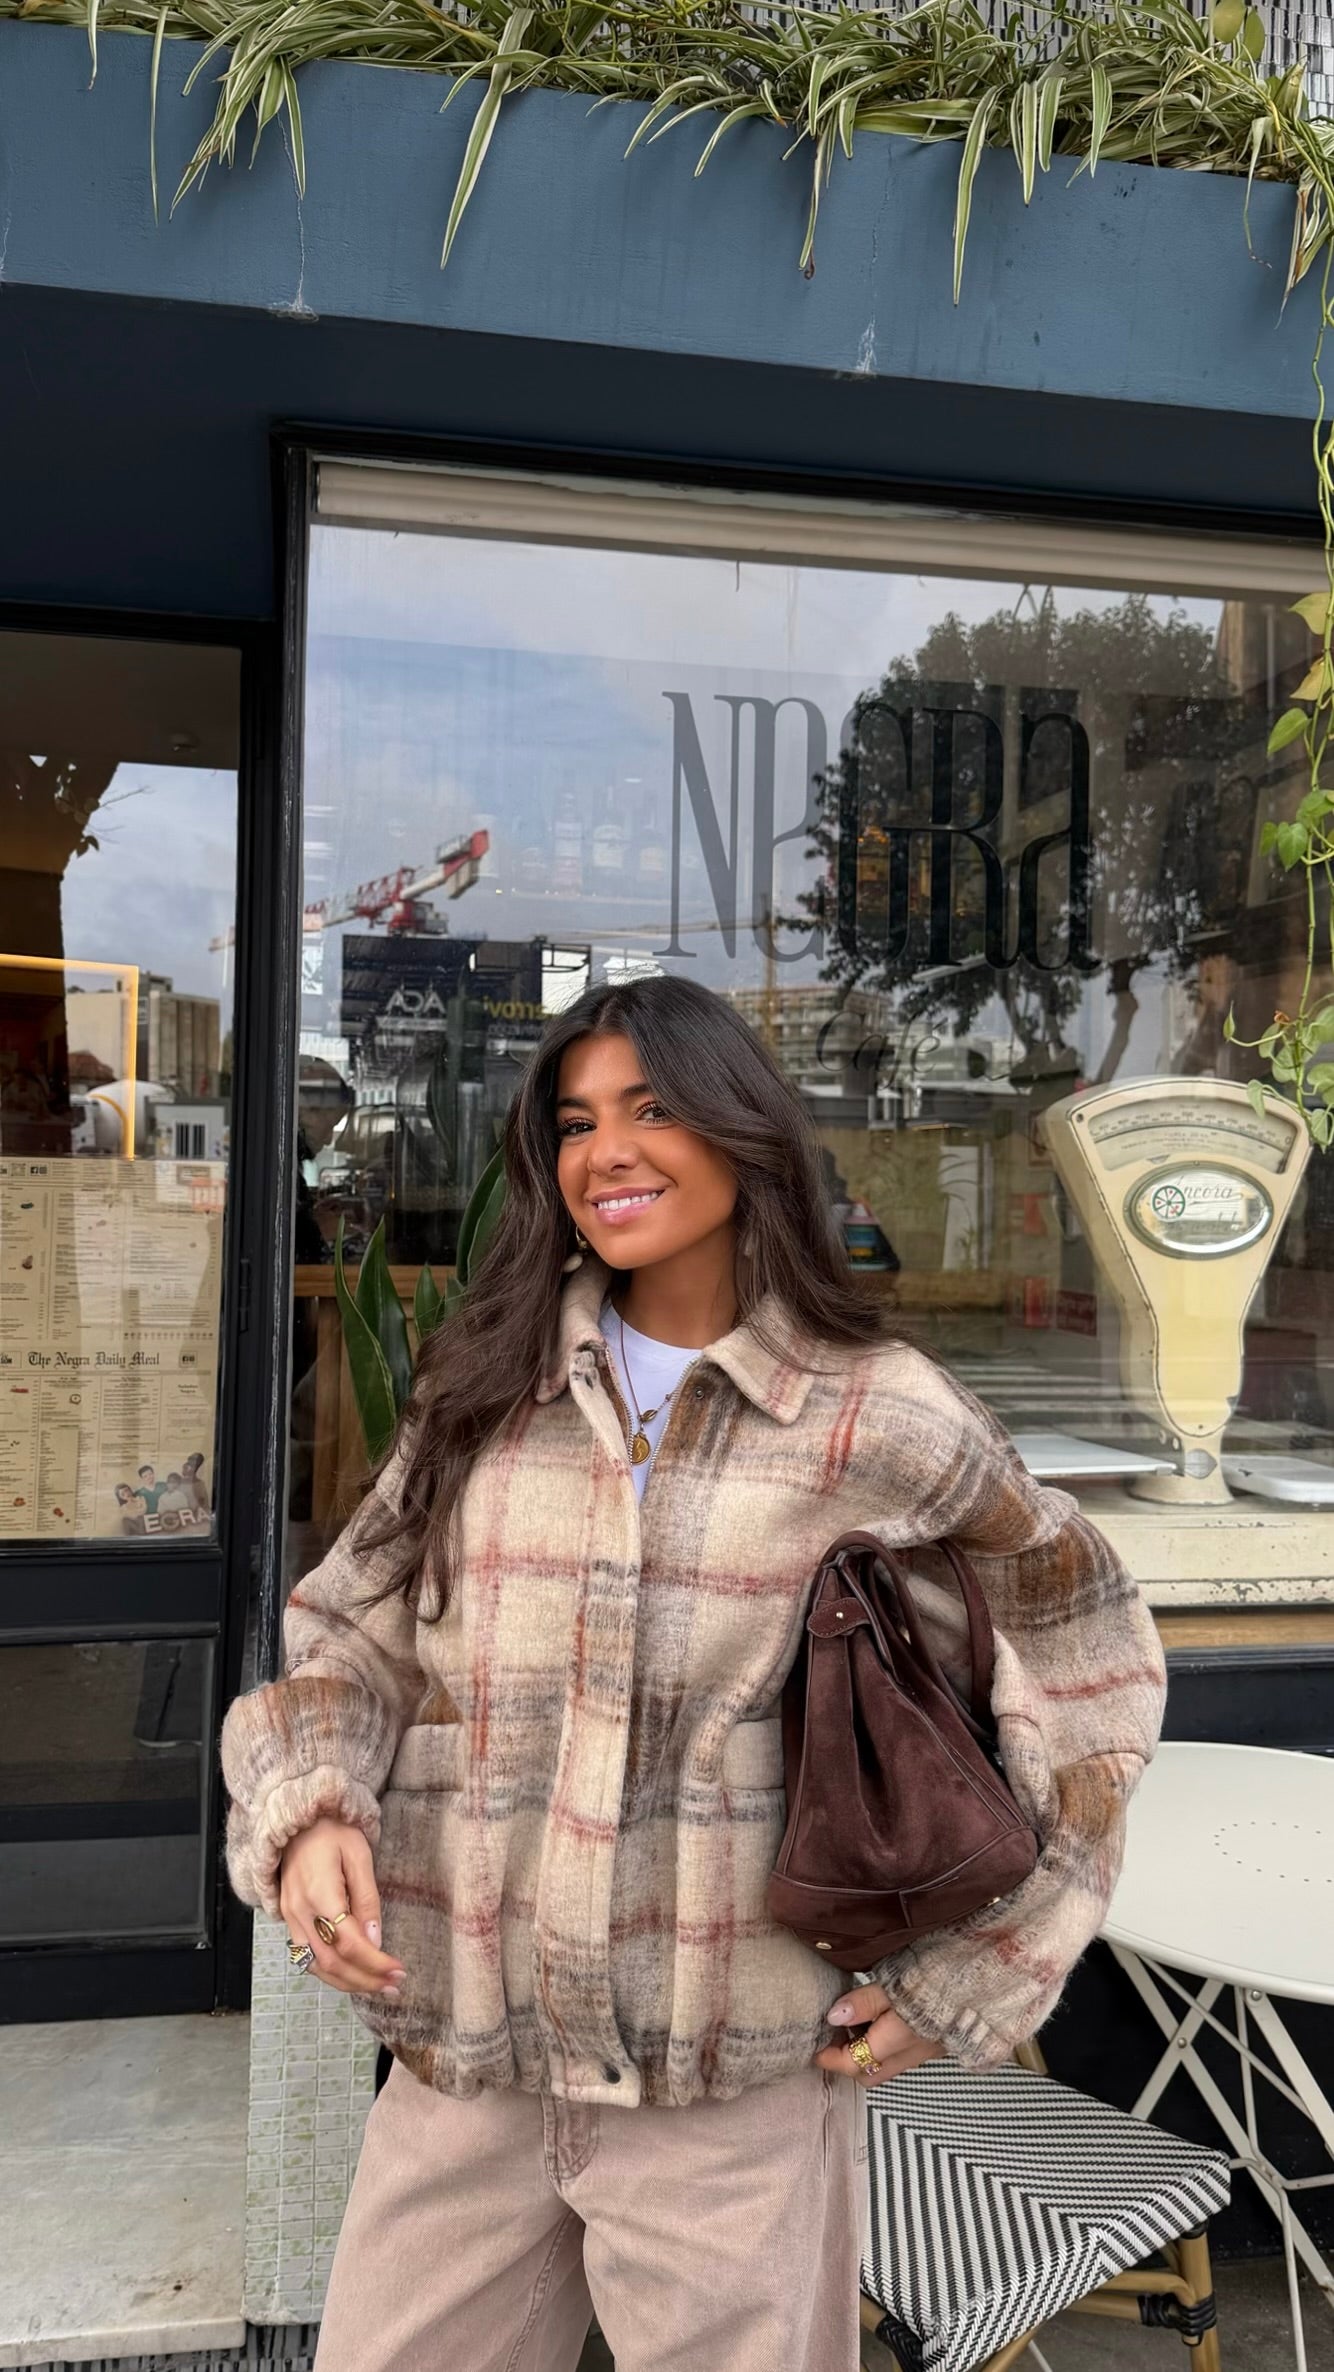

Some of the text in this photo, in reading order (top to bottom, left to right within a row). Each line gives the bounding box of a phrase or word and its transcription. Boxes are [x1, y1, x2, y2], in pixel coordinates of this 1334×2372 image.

[817, 1012, 943, 1089] Café
[29, 1352, 51, 1369] The
[54, 1353, 90, 1369] Negra
[95, 1352, 126, 1369] Daily
[130, 1352, 160, 1369] Meal
